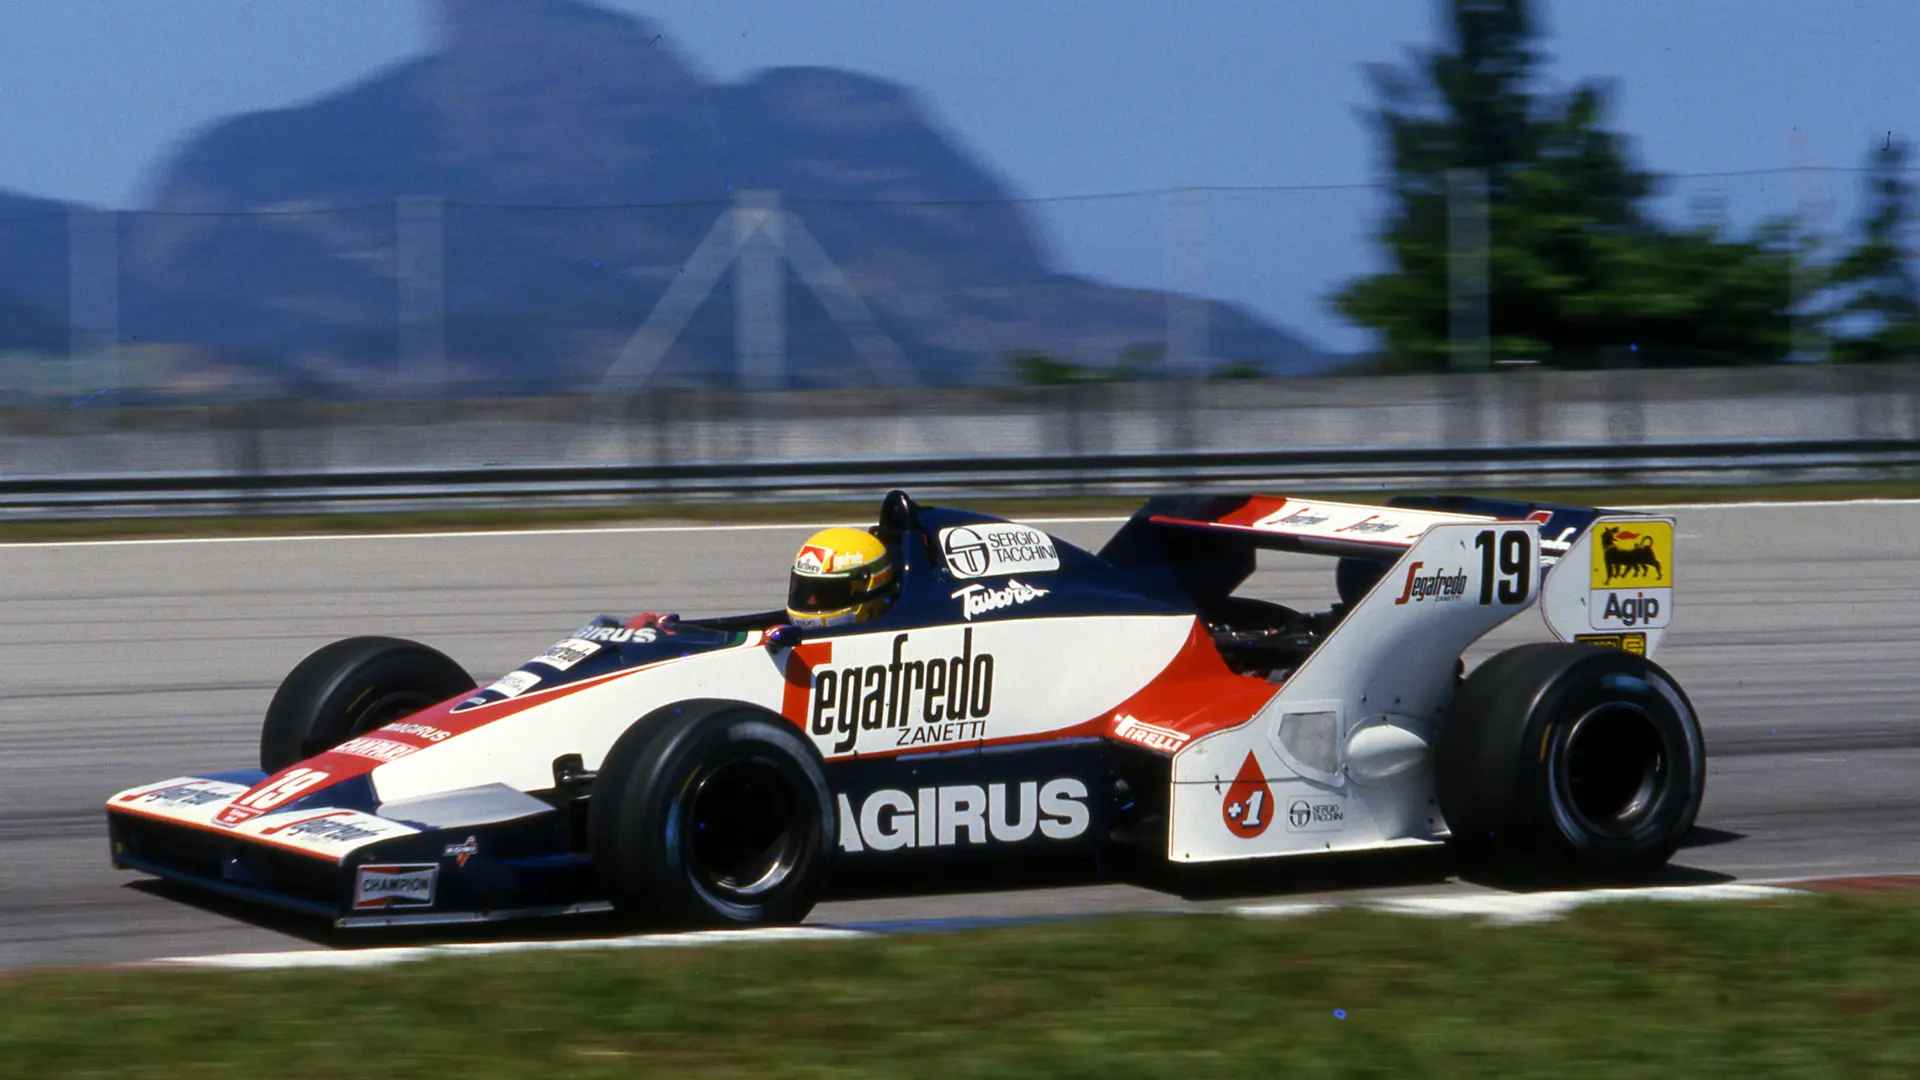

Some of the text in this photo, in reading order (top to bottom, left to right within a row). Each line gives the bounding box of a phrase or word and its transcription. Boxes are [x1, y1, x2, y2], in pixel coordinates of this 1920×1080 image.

[988, 530, 1041, 548] SERGIO
[992, 545, 1057, 563] TACCHINI
[1395, 561, 1467, 605] Segafredo
[1475, 530, 1531, 606] 19
[1603, 592, 1659, 626] Agip
[781, 627, 994, 754] Segafredo
[896, 720, 985, 746] ZANETTI
[1114, 714, 1191, 752] PIRELLI
[238, 767, 331, 810] 19
[1226, 790, 1264, 828] +1
[362, 877, 430, 893] CHAMPION
